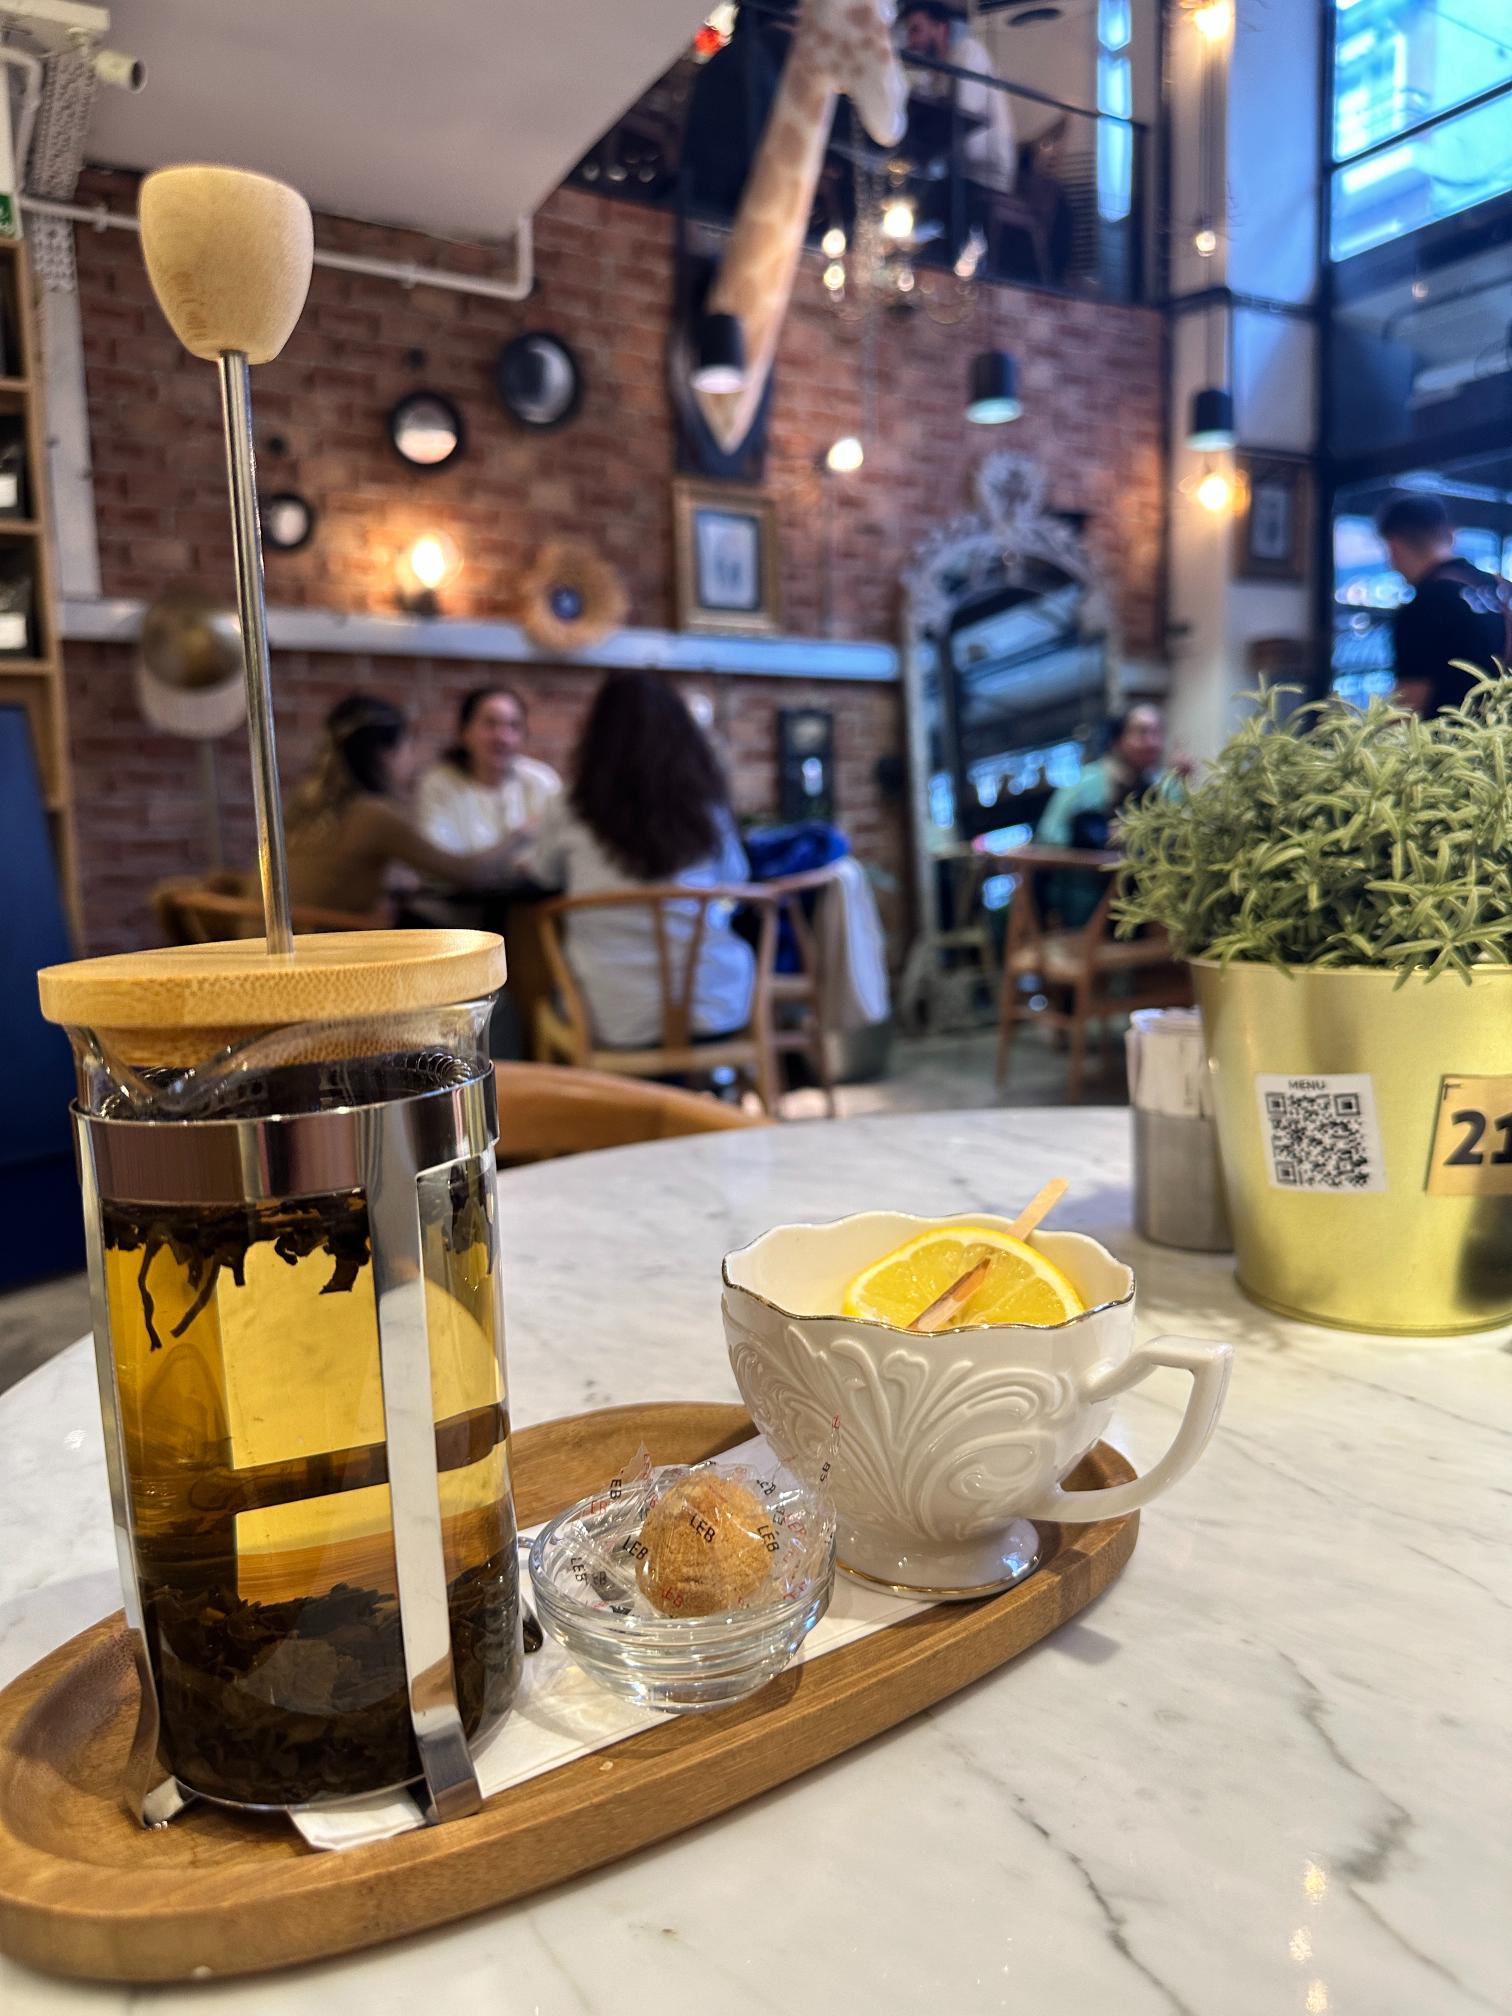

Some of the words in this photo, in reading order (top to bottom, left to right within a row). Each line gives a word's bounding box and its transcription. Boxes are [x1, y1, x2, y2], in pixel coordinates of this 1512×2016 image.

[1288, 1079, 1326, 1090] MENU
[1443, 1109, 1512, 1166] 21
[689, 1515, 716, 1543] LEB
[757, 1525, 780, 1552] LEB
[622, 1535, 649, 1560] LEB
